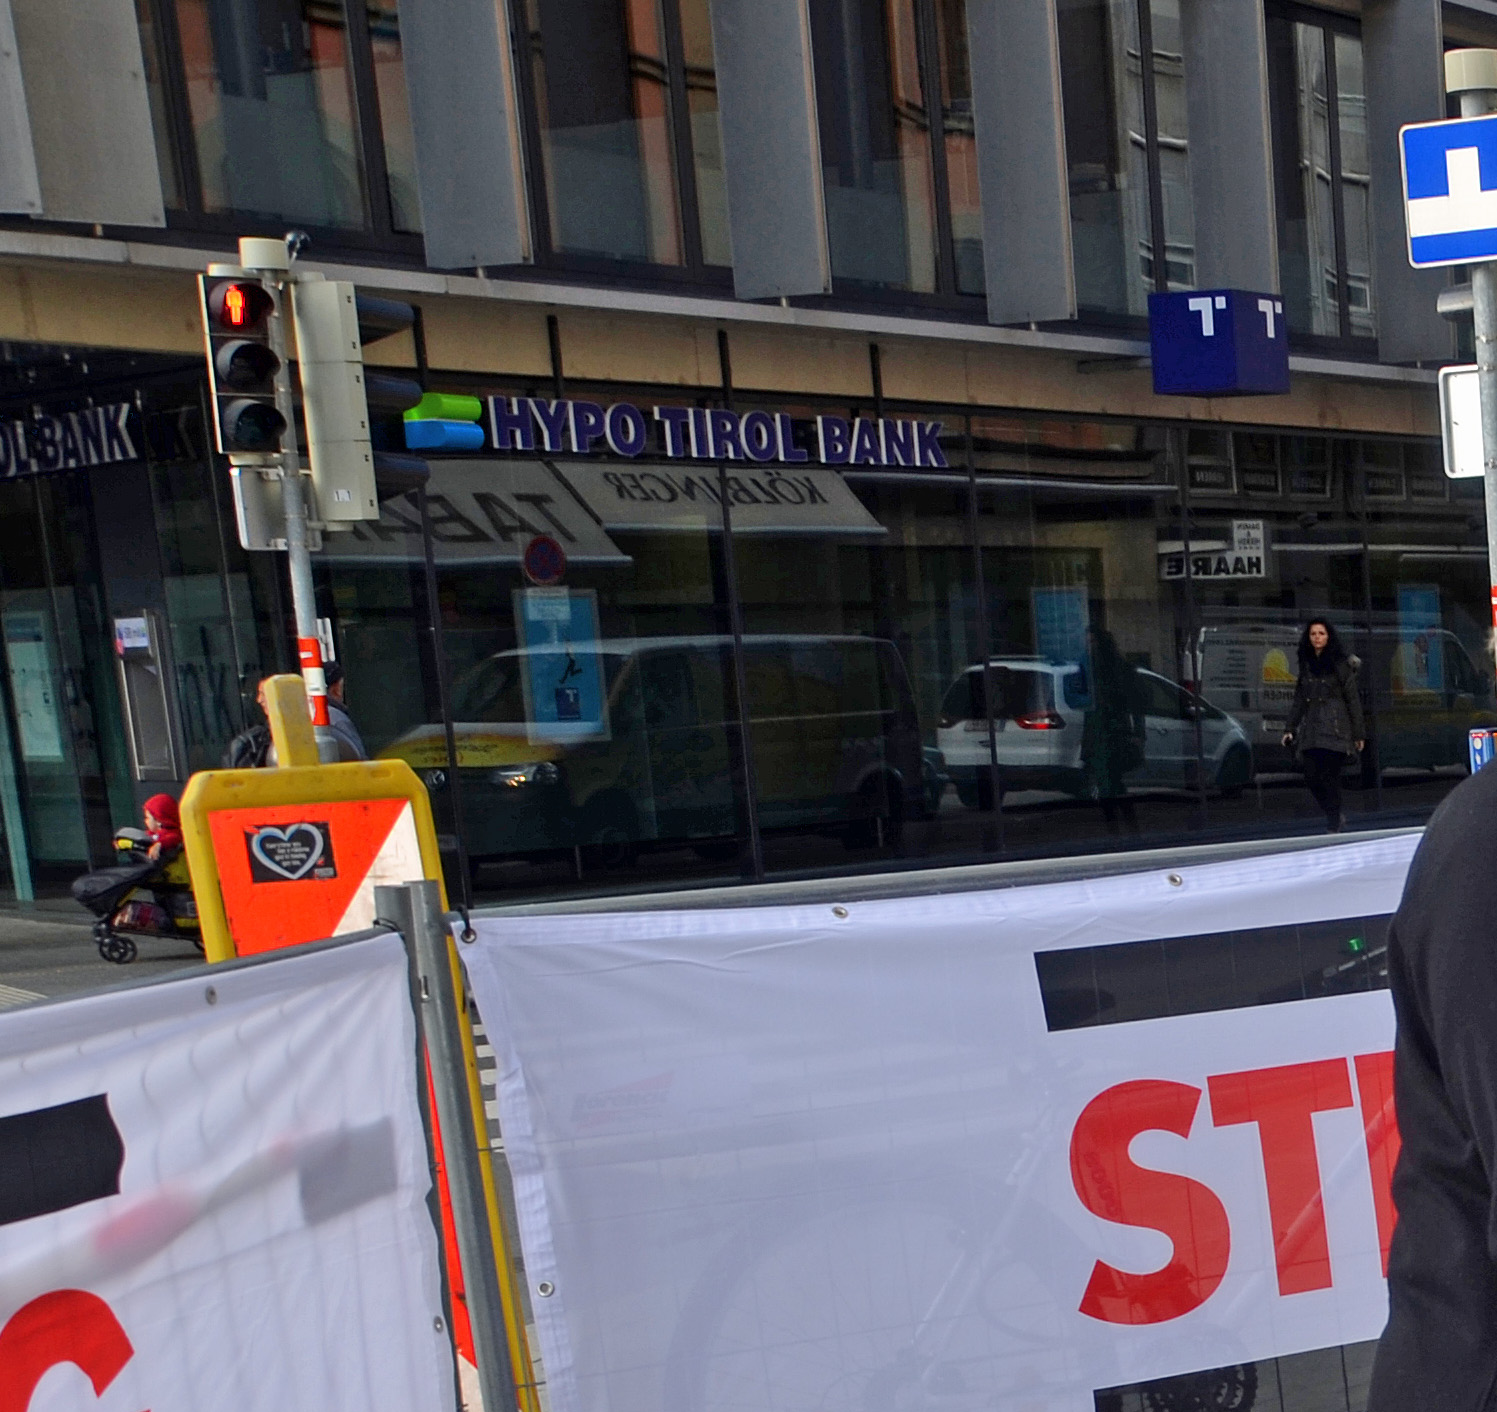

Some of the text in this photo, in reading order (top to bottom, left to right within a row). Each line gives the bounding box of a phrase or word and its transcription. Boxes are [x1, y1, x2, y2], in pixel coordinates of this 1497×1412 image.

[36, 403, 138, 471] BANK
[488, 395, 948, 467] HYPO TIROL BANK
